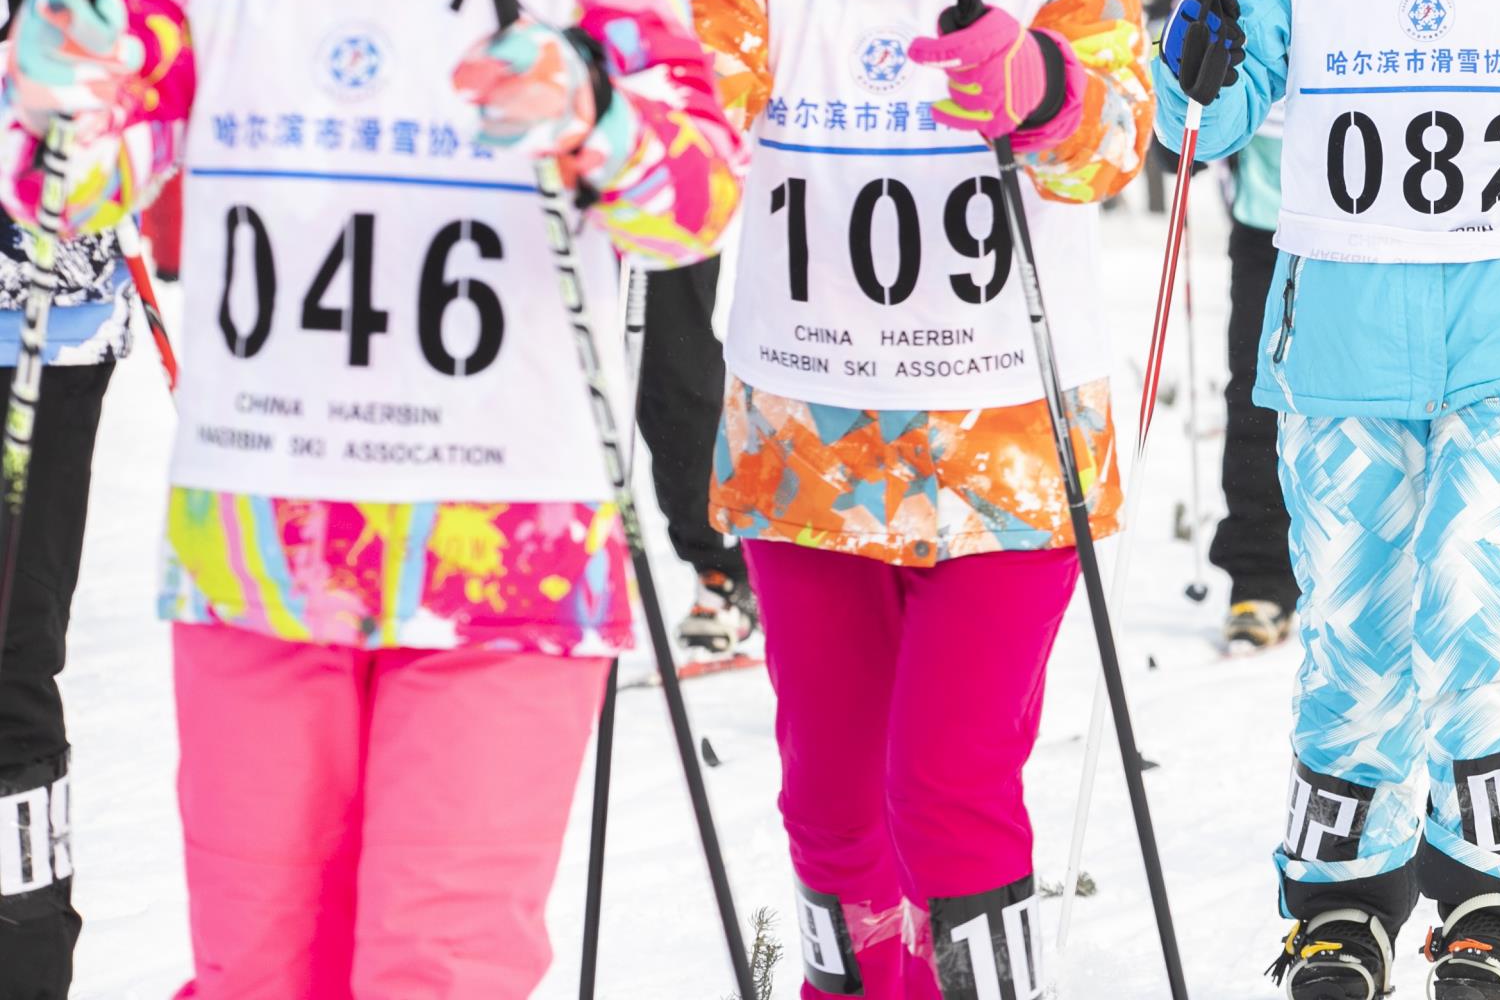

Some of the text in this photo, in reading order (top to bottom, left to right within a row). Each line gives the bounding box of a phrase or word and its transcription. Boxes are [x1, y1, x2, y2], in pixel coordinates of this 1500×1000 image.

[766, 97, 952, 132] 哈尔滨市滑雪
[770, 175, 1014, 306] 109
[217, 204, 505, 378] 046
[795, 325, 974, 347] CHINA HAERBIN
[759, 345, 1025, 377] HAERBIN SKI ASSOCATION
[235, 392, 443, 425] CHINA HAERBIN
[197, 424, 506, 466] HAERBIN SKI ASSOCATION
